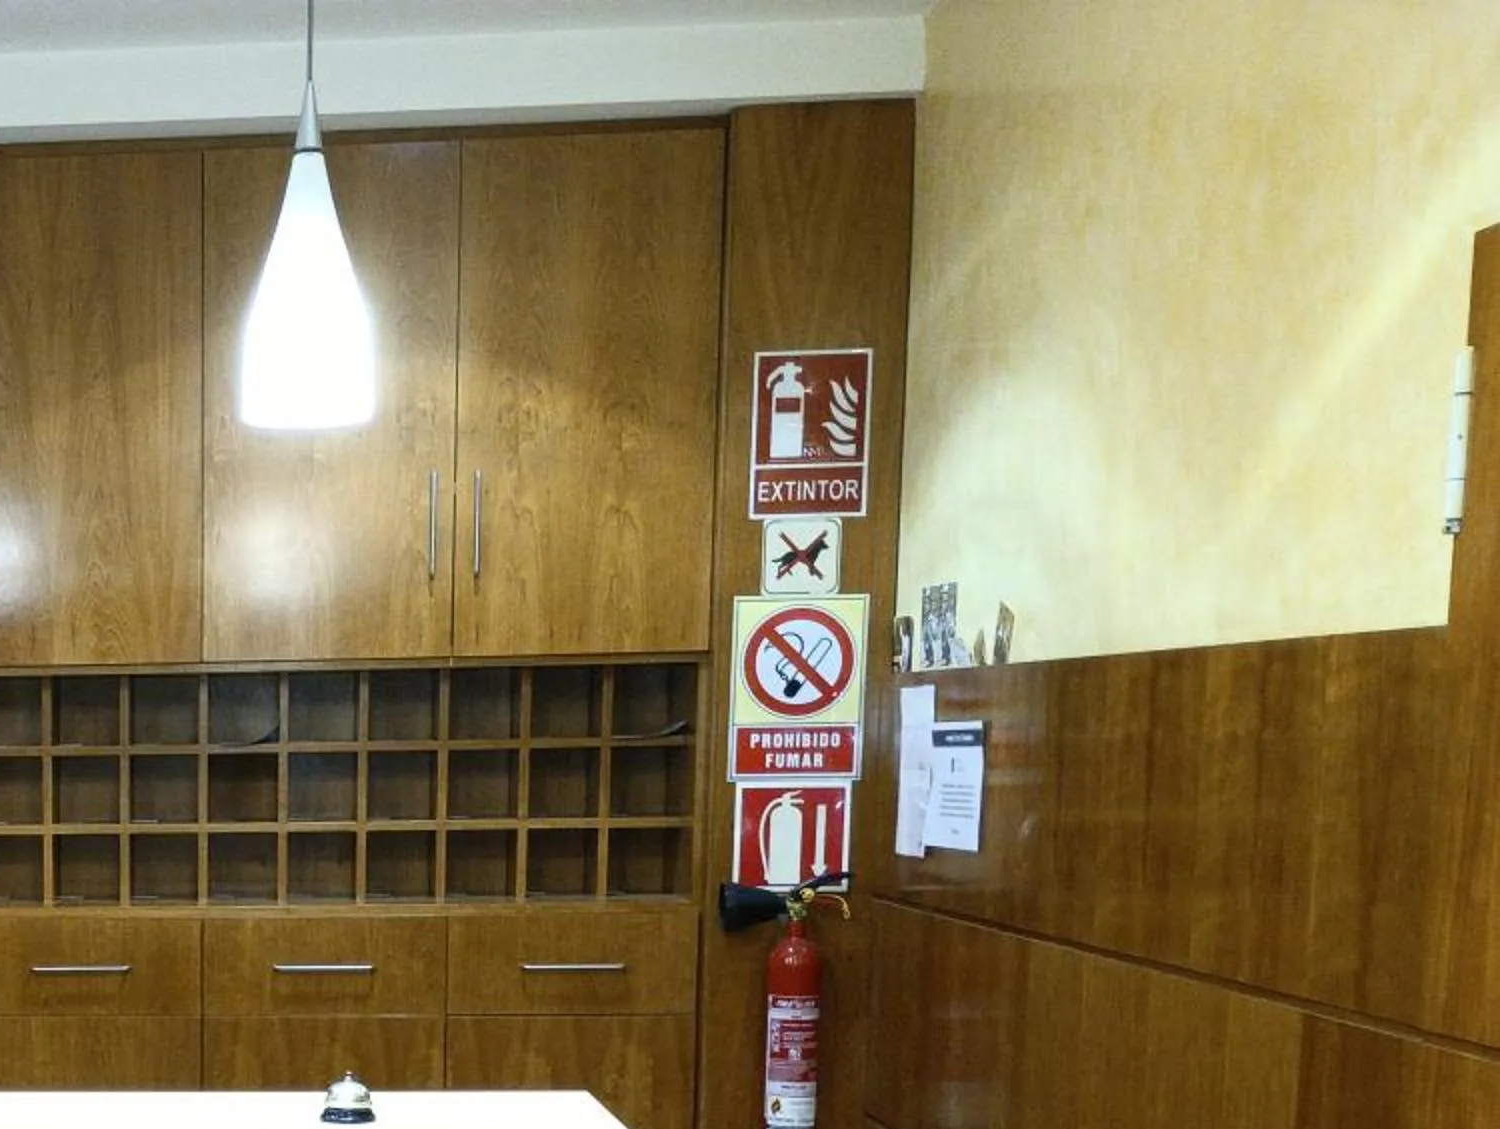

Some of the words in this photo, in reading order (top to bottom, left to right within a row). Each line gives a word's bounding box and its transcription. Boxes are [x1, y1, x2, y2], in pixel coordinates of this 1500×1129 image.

[757, 479, 859, 503] EXTINTOR
[749, 732, 841, 749] PROHIBIDO
[764, 752, 824, 769] FUMAR
